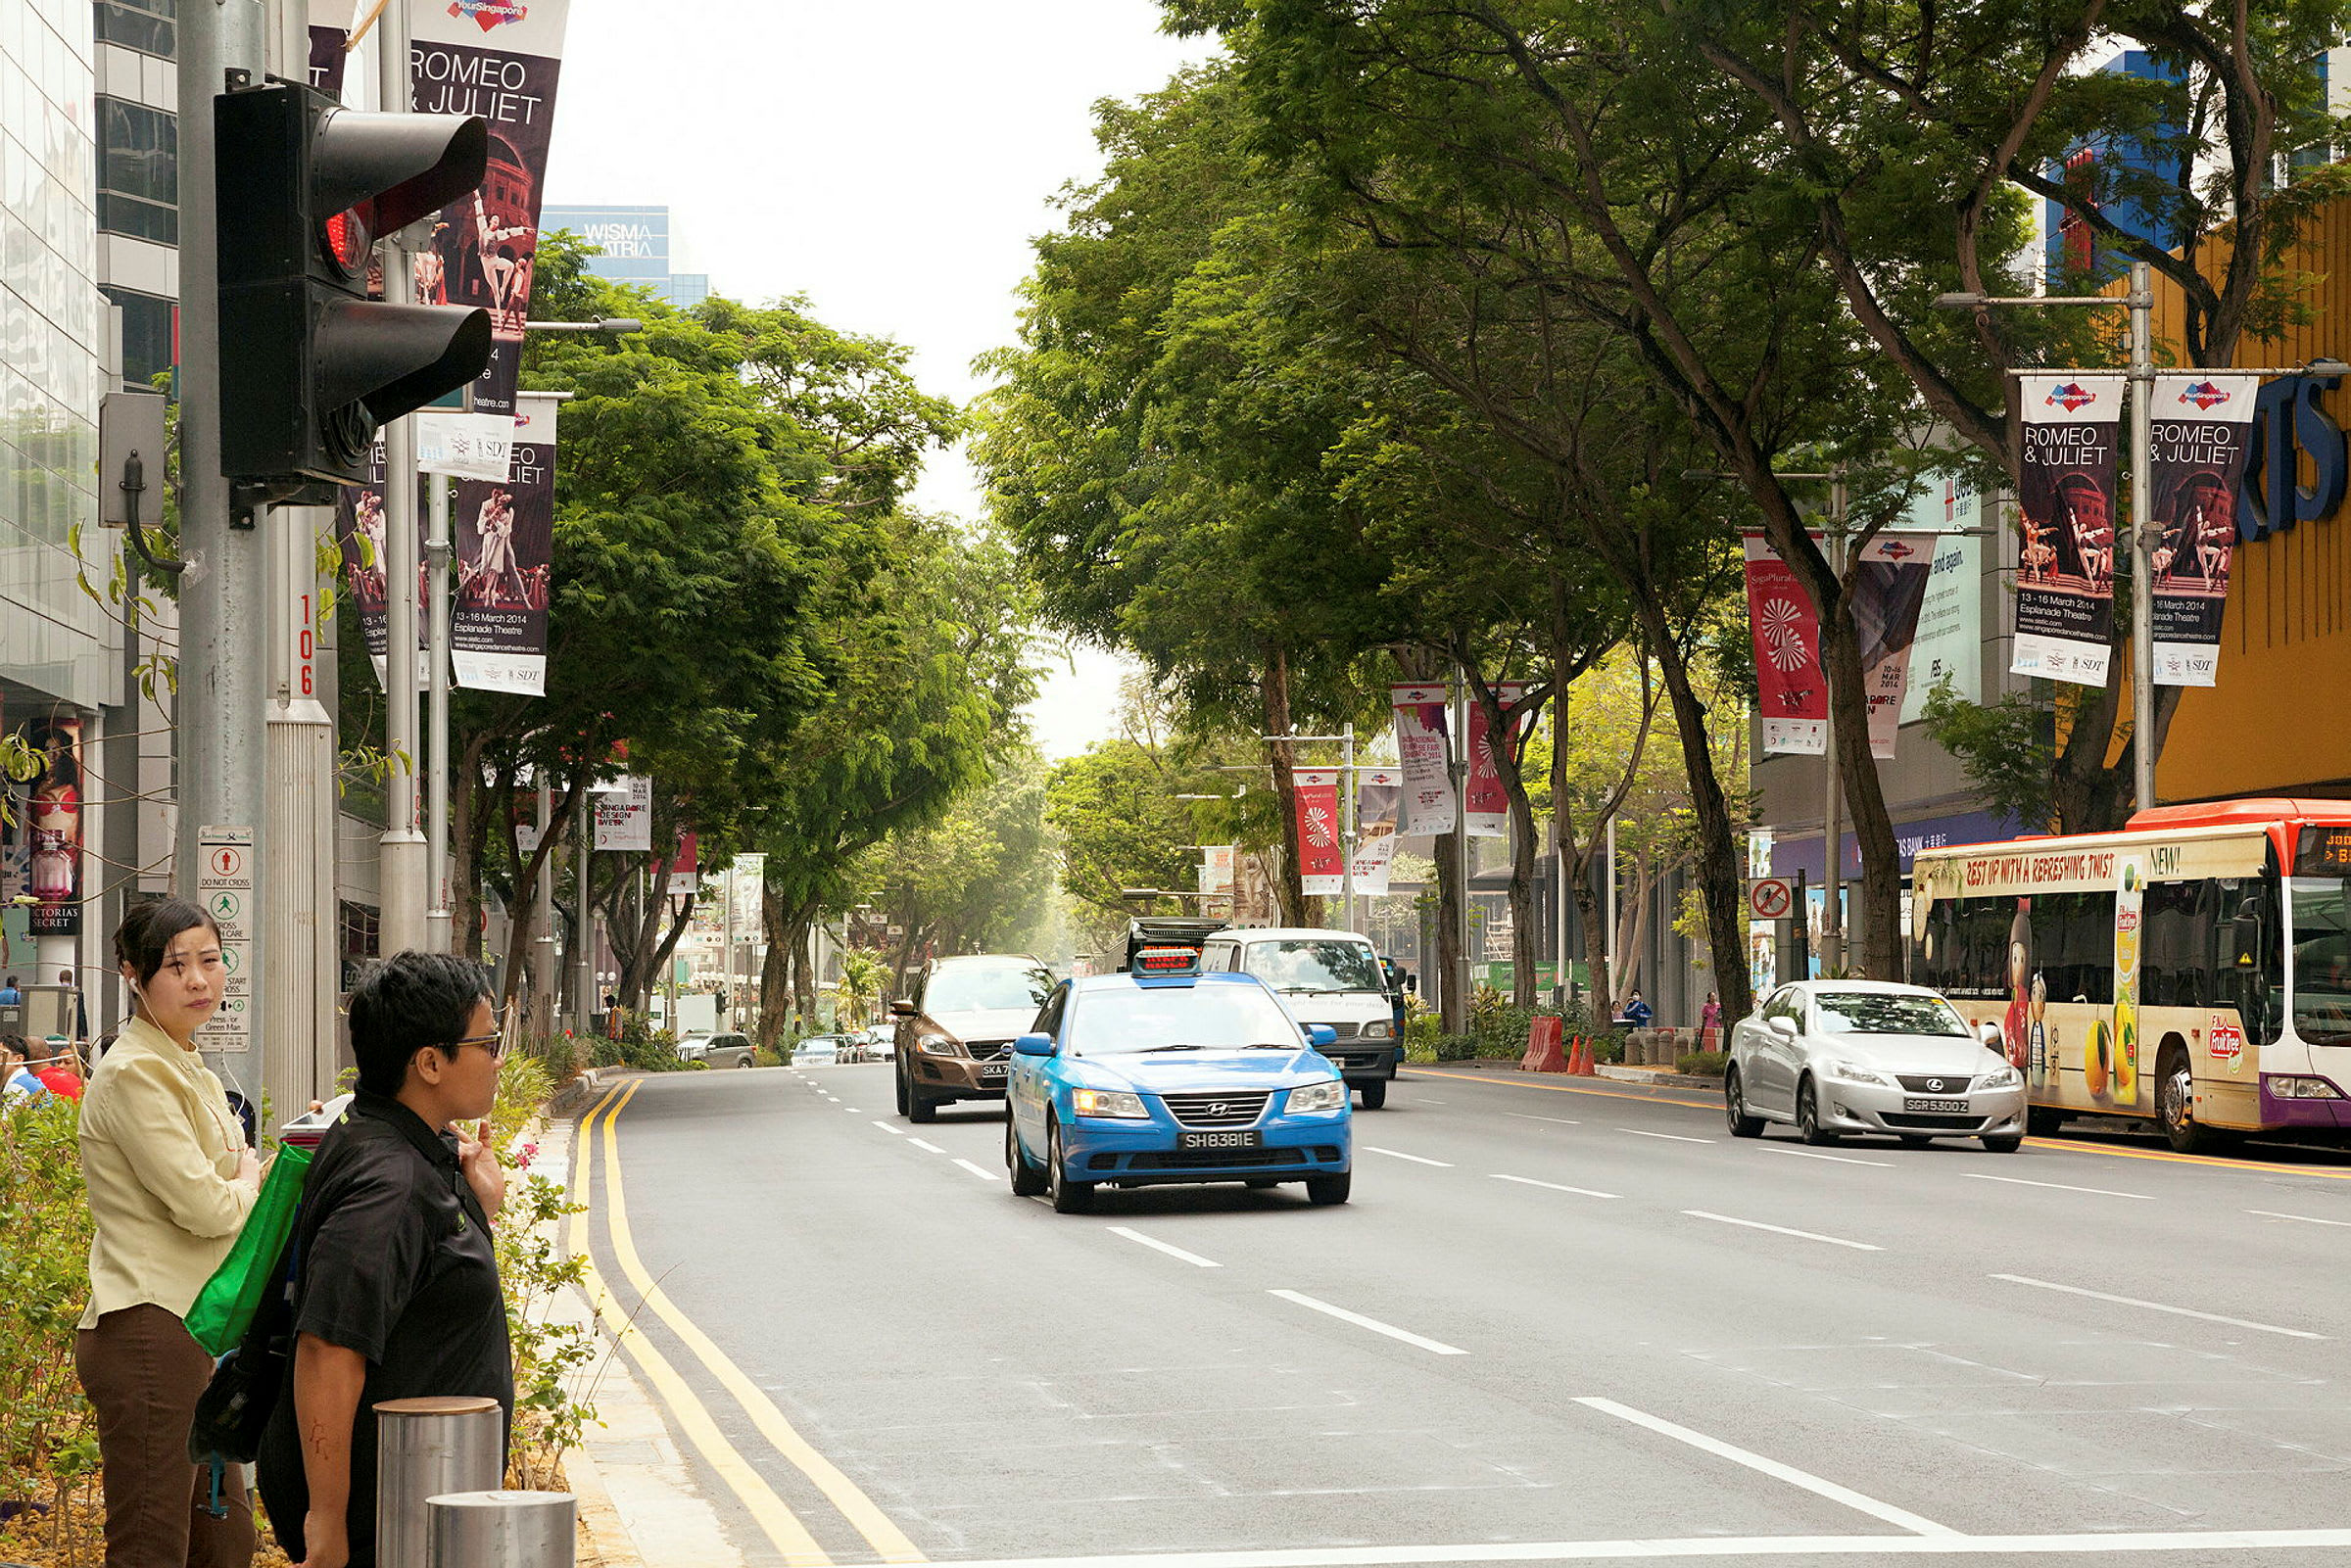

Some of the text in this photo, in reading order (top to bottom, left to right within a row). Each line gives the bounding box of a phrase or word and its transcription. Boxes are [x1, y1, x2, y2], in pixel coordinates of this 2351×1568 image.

[411, 49, 525, 90] ROMEO
[429, 84, 542, 124] JULIET
[584, 223, 652, 241] WISMA
[2025, 427, 2097, 447] ROMEO
[2150, 424, 2231, 445] ROMEO
[2024, 446, 2108, 466] & JULIET
[2150, 444, 2239, 464] & JULIET
[2021, 593, 2032, 602] 13
[2039, 594, 2049, 604] 16
[2049, 595, 2076, 607] March
[2077, 599, 2095, 610] 2014
[2164, 600, 2185, 610] March
[2185, 601, 2205, 611] 2014
[456, 611, 465, 621] 13
[470, 613, 480, 622] 16
[480, 613, 504, 623] March
[506, 614, 527, 624] 2014
[2019, 603, 2092, 622] Esplanade Theatre
[2175, 612, 2200, 622] Theatre
[454, 622, 523, 636] Esplanade Theatre
[300, 594, 312, 695] 106
[1988, 858, 2000, 885] UP
[2000, 856, 2022, 885] WITH
[2023, 856, 2031, 884] A
[2033, 853, 2086, 883] REFRESHING
[2149, 845, 2181, 876] NEW!
[983, 1065, 1009, 1076] SKA7
[1906, 1099, 1969, 1113] SGR5300Z
[1185, 1132, 1255, 1148] SH8381E
